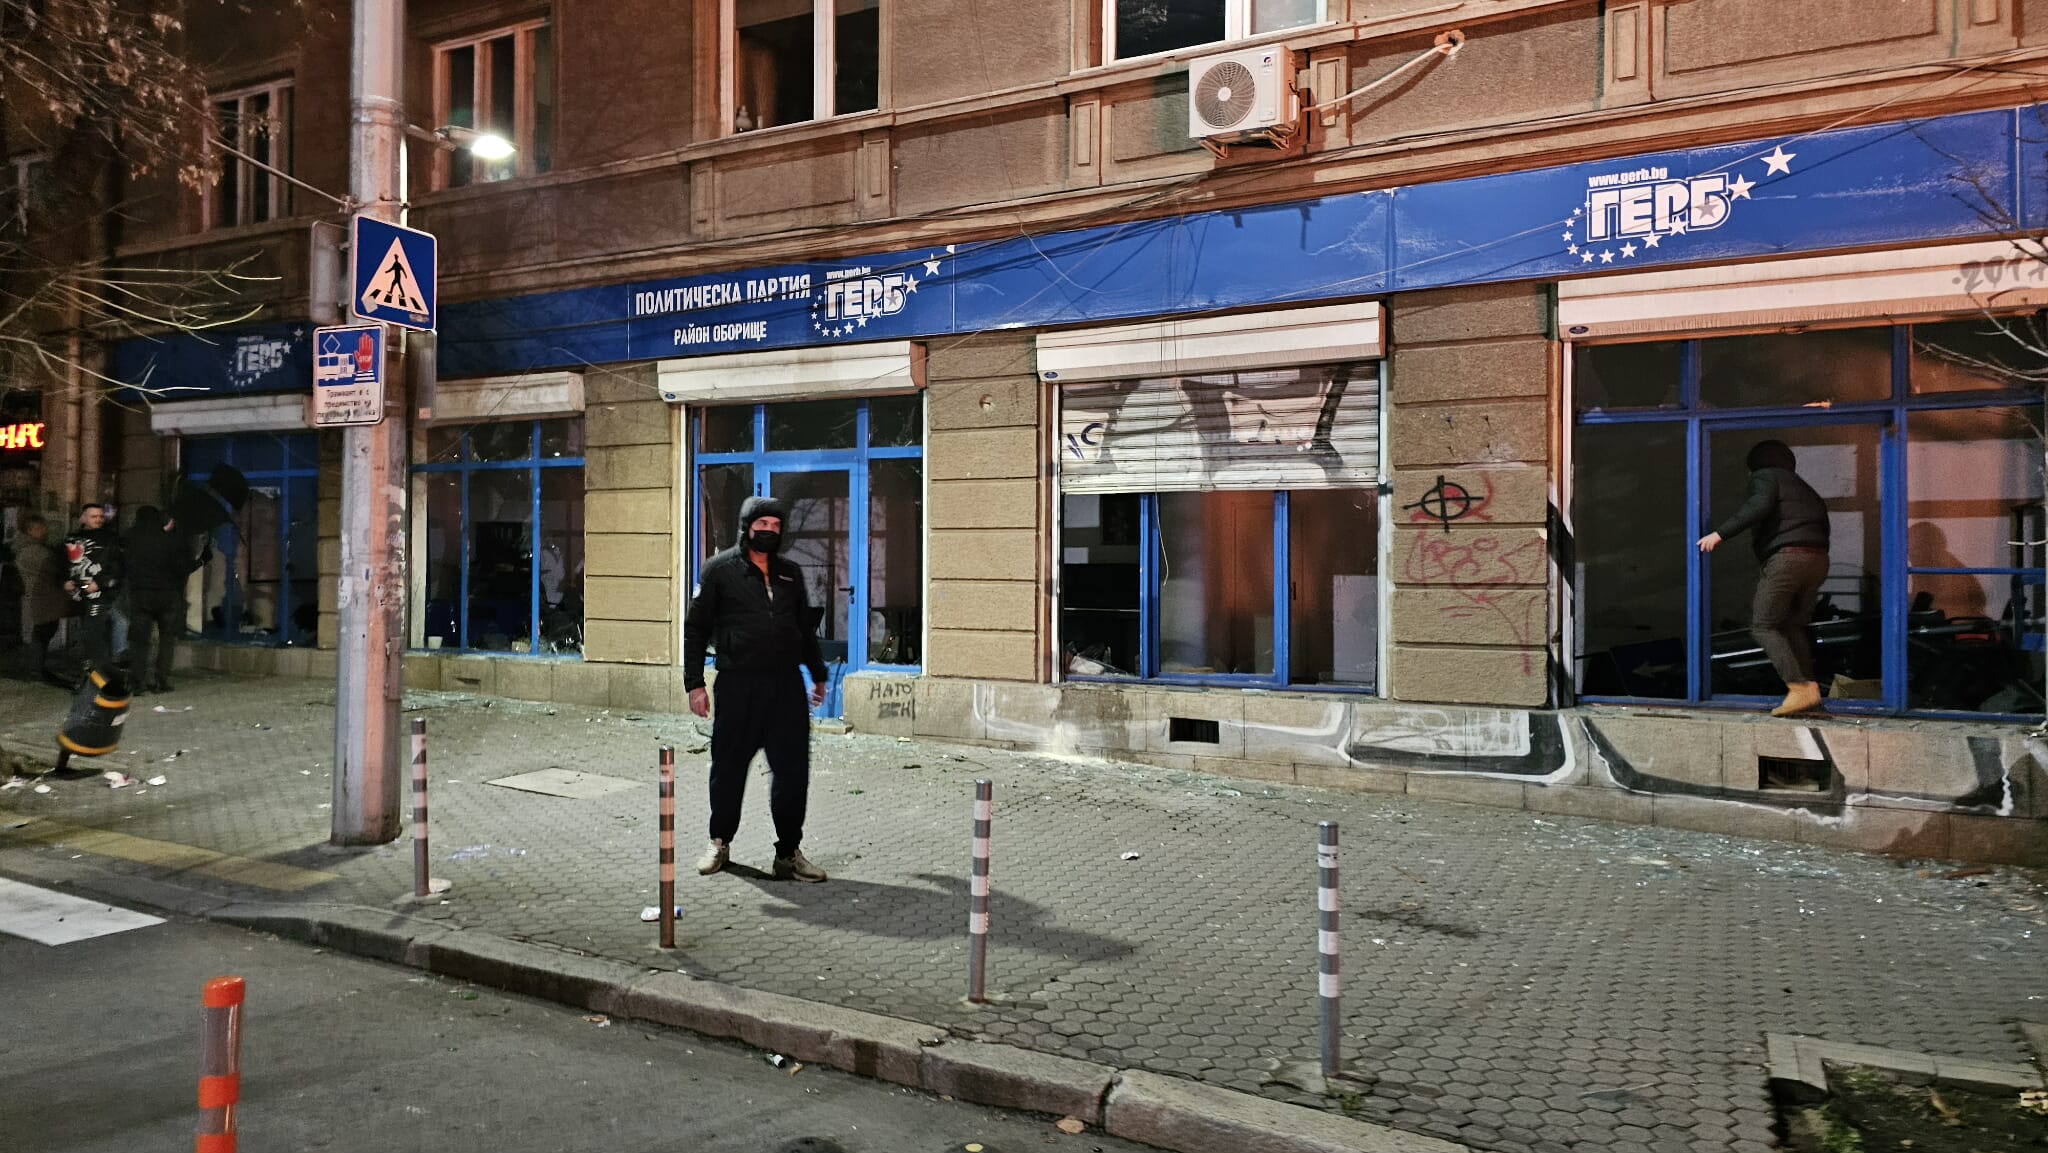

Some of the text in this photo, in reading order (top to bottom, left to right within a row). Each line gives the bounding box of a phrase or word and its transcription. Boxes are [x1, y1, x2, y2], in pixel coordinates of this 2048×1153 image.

[1589, 167, 1668, 187] www.gerb.bg
[1588, 174, 1729, 241] ГЕРБ
[635, 273, 811, 315] ПОЛИТИЧЕСКА ПАРТИЯ
[826, 274, 905, 319] ГЕРБ
[674, 320, 768, 346] РАЙОН ОБОРИЩЕ
